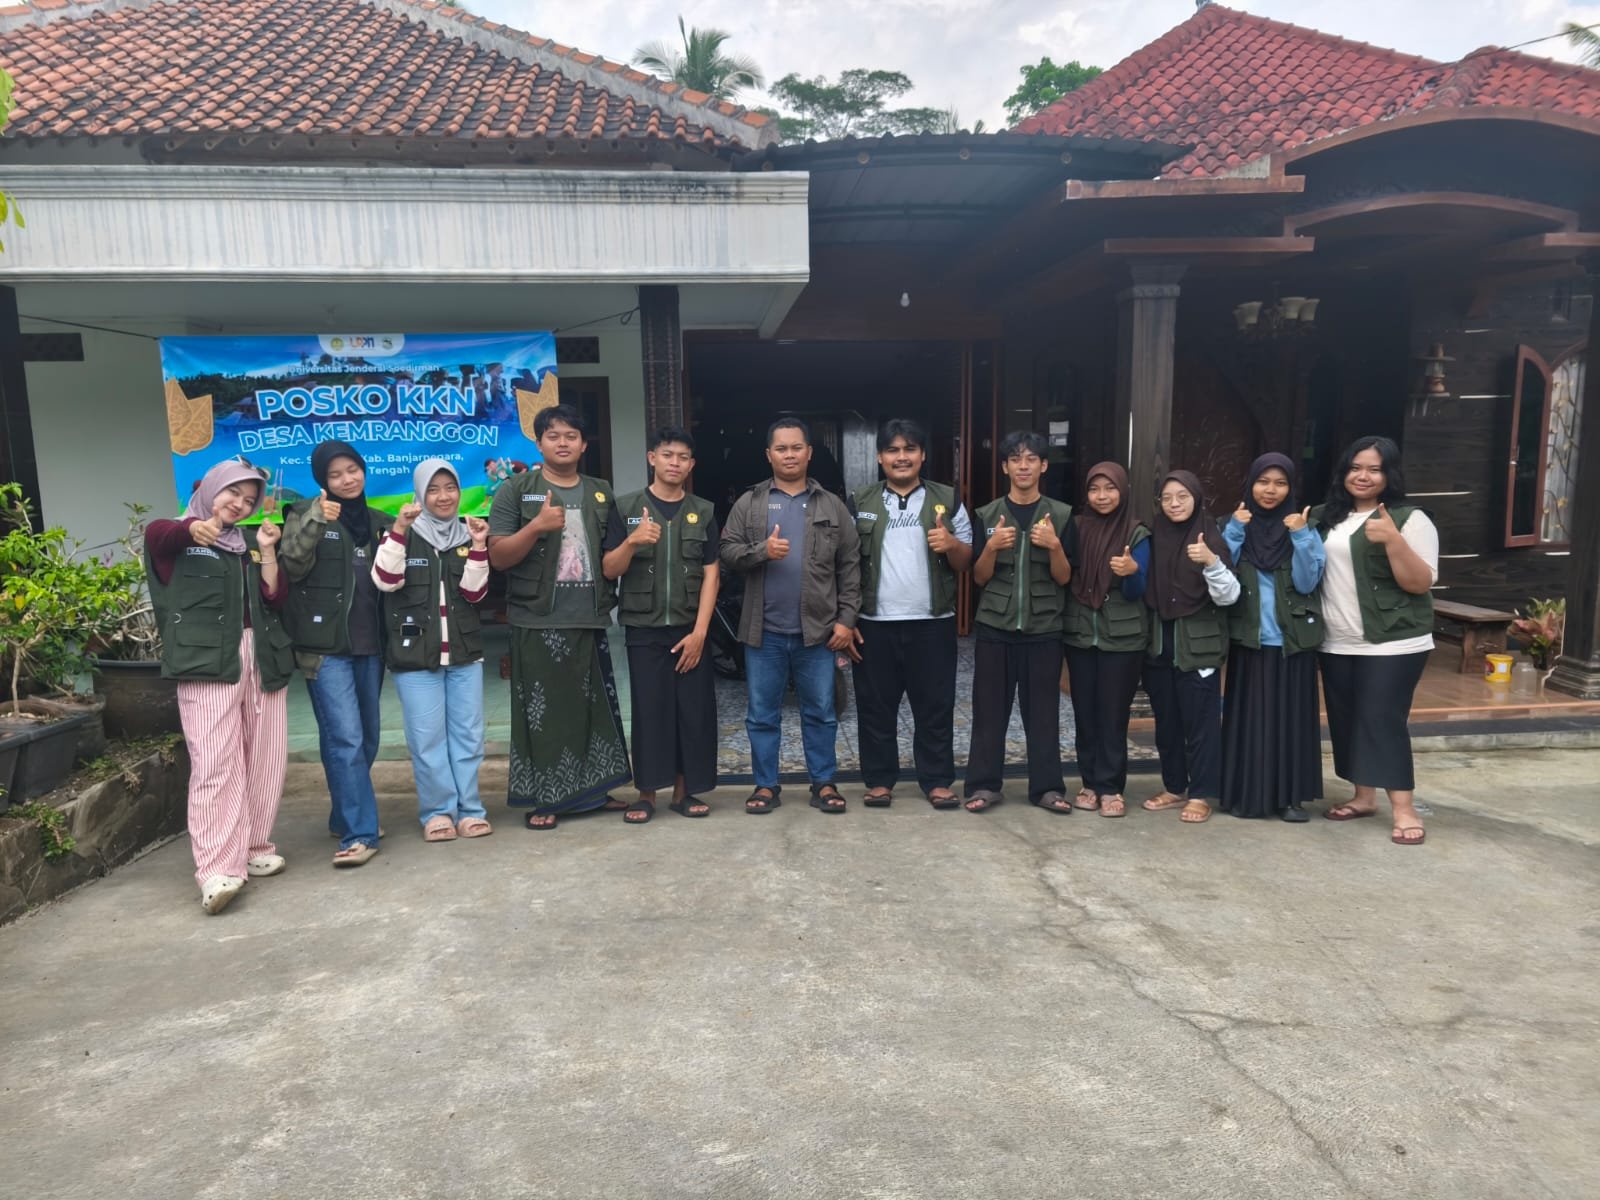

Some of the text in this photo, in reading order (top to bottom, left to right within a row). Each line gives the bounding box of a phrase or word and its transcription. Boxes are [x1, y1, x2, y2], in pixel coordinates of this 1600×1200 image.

[289, 364, 342, 374] Universitas
[388, 363, 440, 373] Soedirman
[255, 384, 476, 421] POSKO KKN
[238, 420, 499, 452] DESA KEMRANGGON
[280, 456, 304, 465] Kec.
[361, 454, 385, 463] Kab.
[368, 465, 410, 476] Tengah
